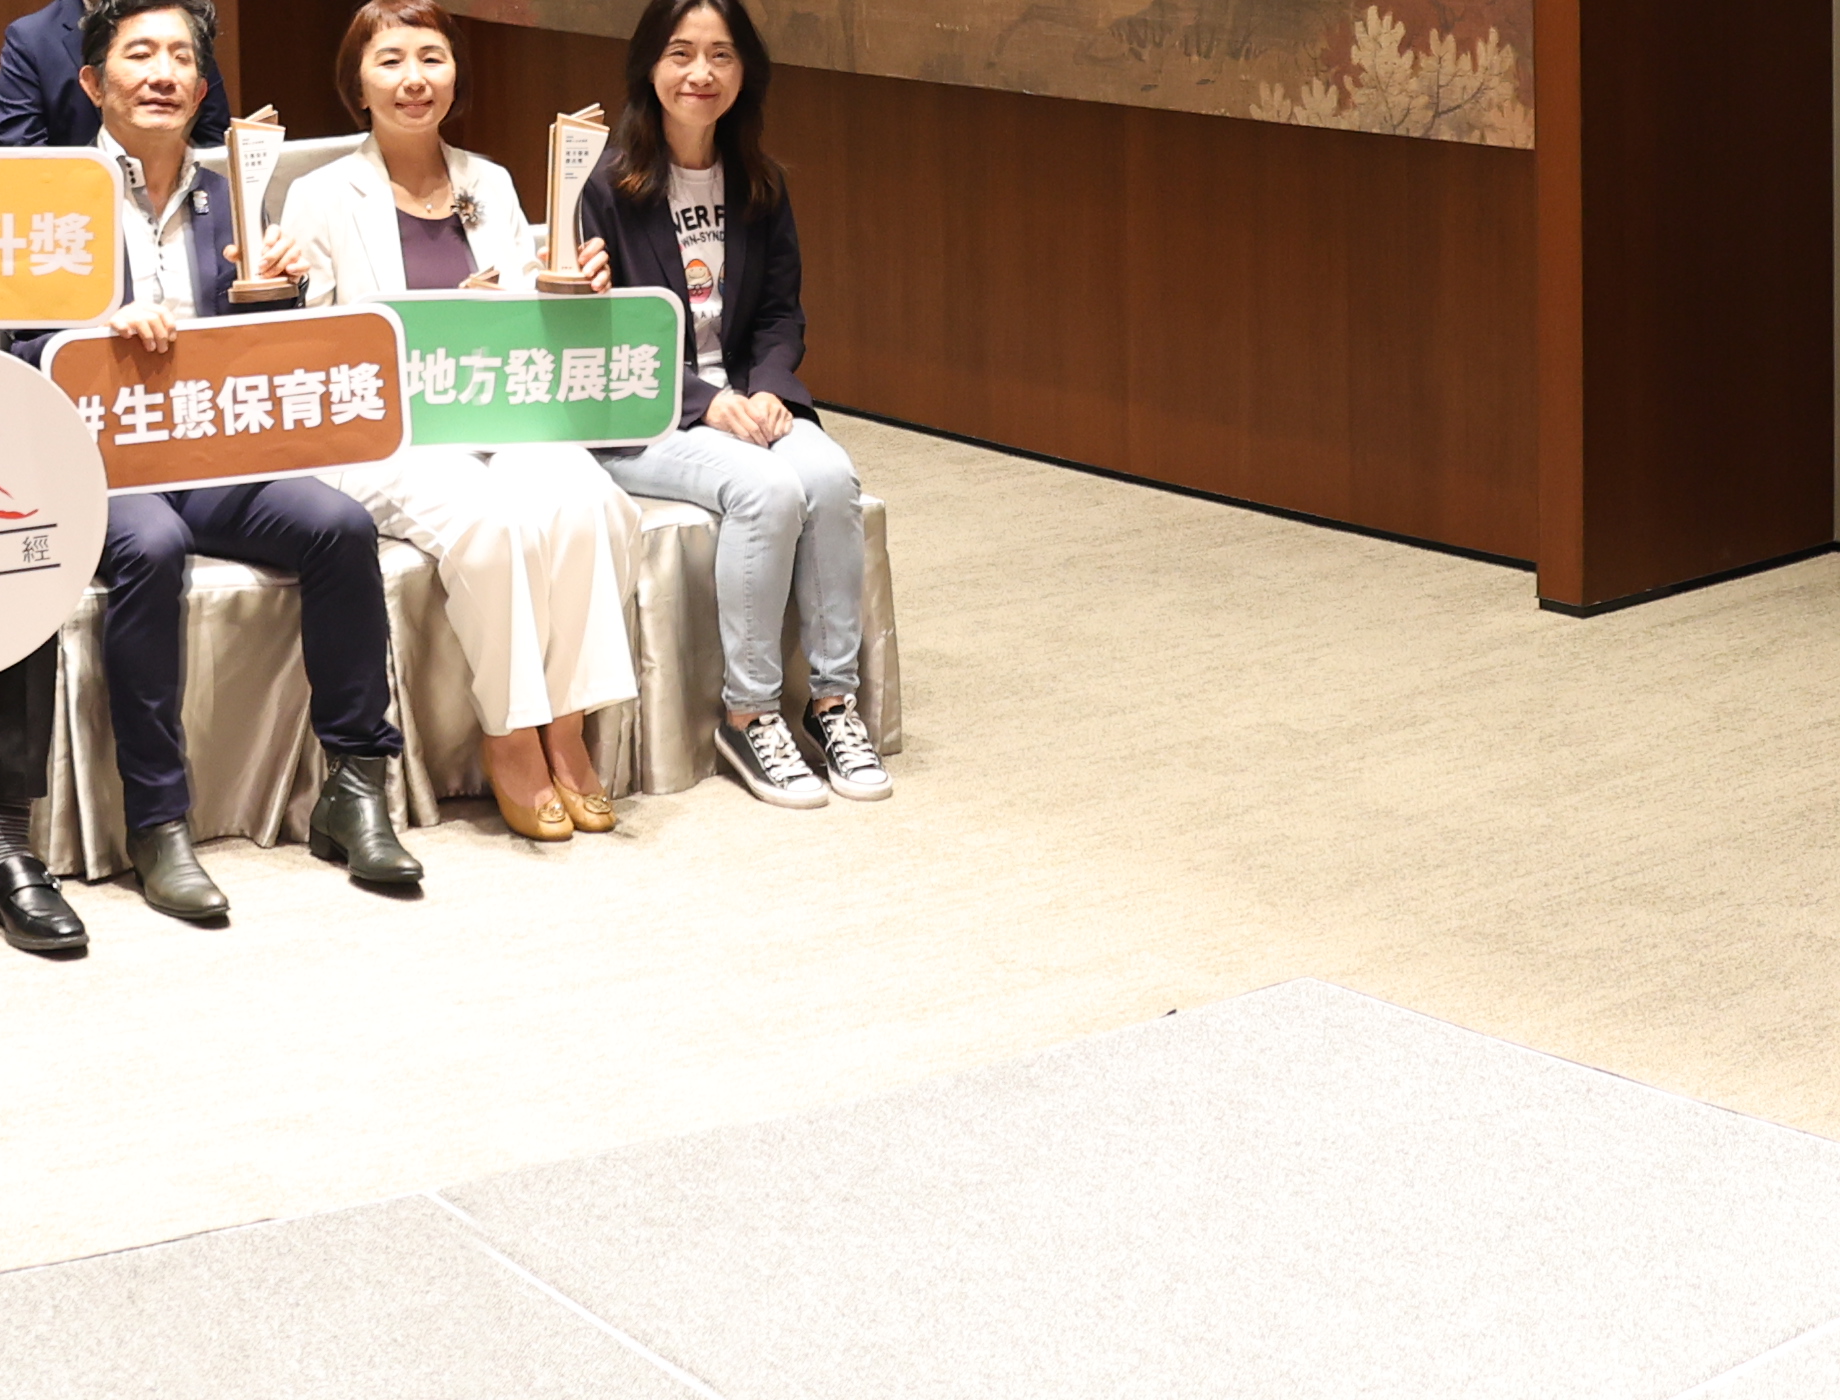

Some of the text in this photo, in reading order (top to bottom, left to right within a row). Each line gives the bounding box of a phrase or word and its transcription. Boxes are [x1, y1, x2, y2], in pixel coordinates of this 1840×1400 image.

[78, 362, 387, 445] #生態保育獎
